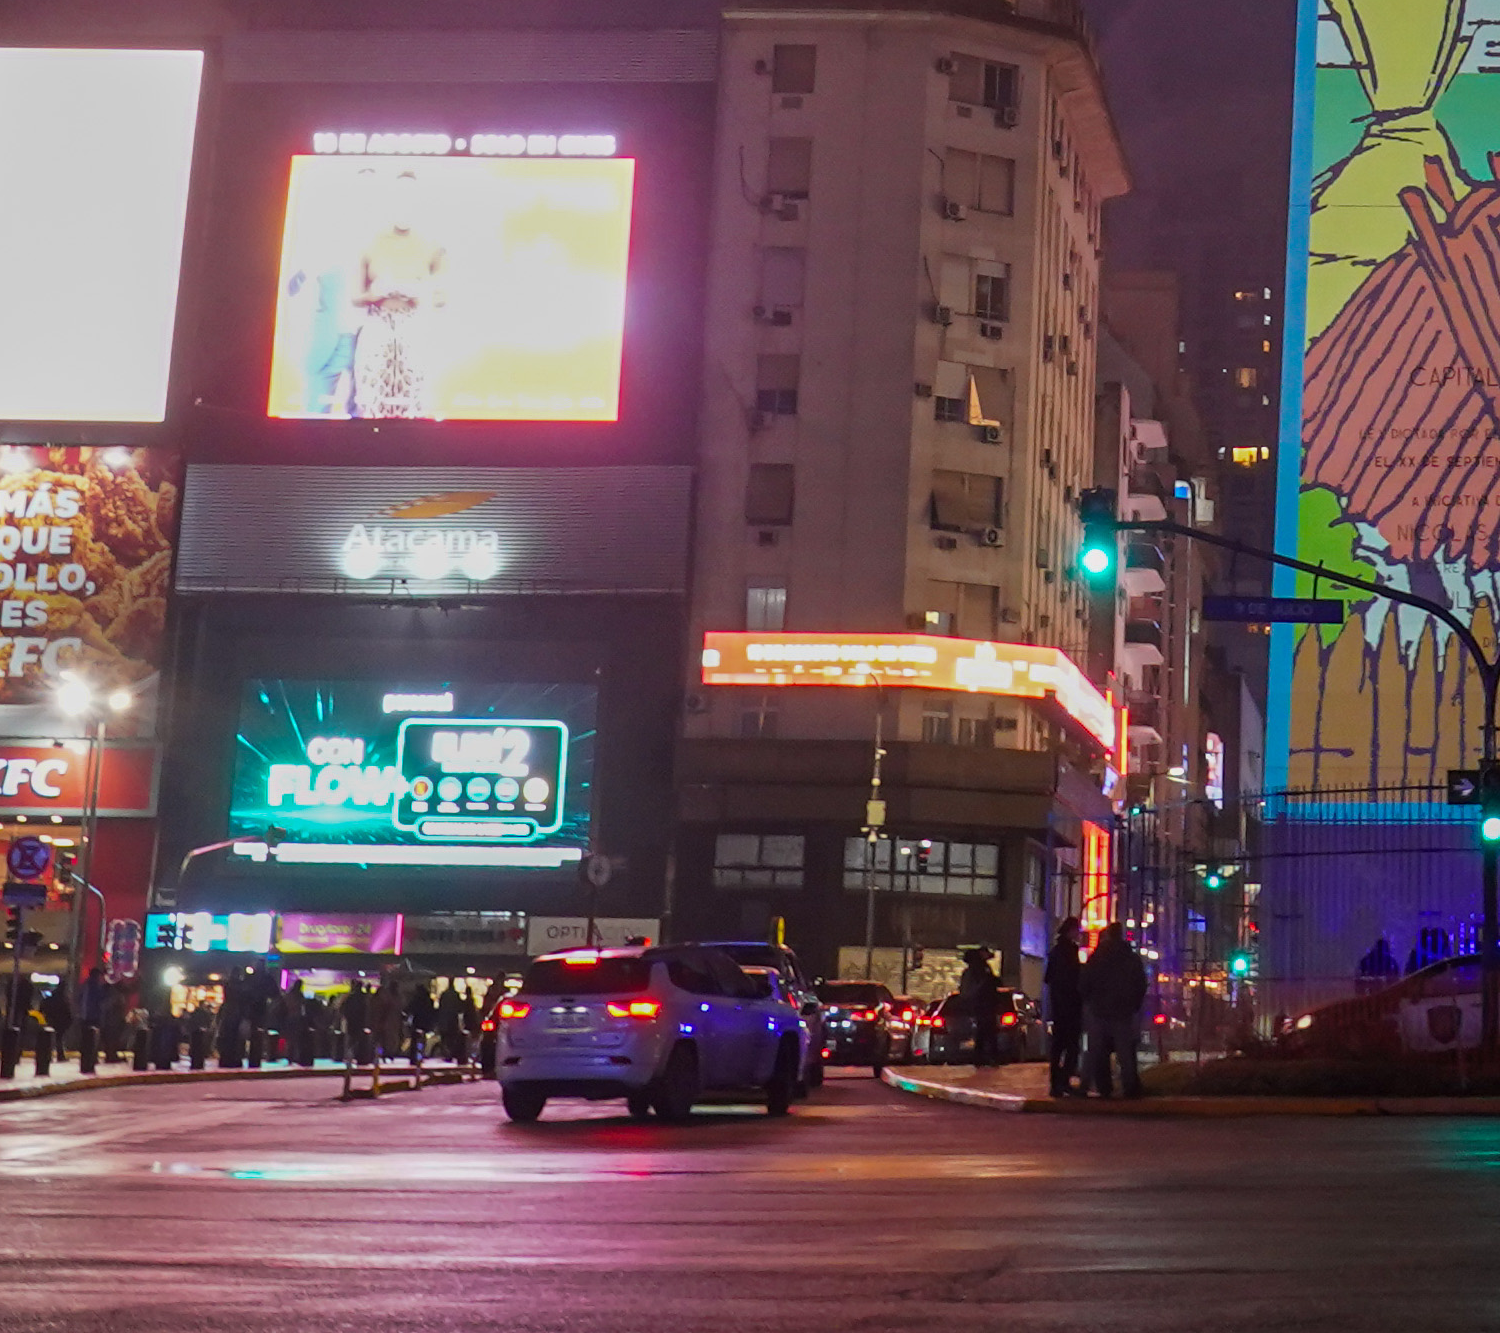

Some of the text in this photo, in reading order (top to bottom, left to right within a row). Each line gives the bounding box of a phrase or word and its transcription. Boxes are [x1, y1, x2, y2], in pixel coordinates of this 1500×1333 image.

[1410, 367, 1499, 387] CAPITAL
[343, 523, 500, 552] Atacama
[1397, 524, 1488, 542] NICOLS
[0, 599, 49, 628] ES
